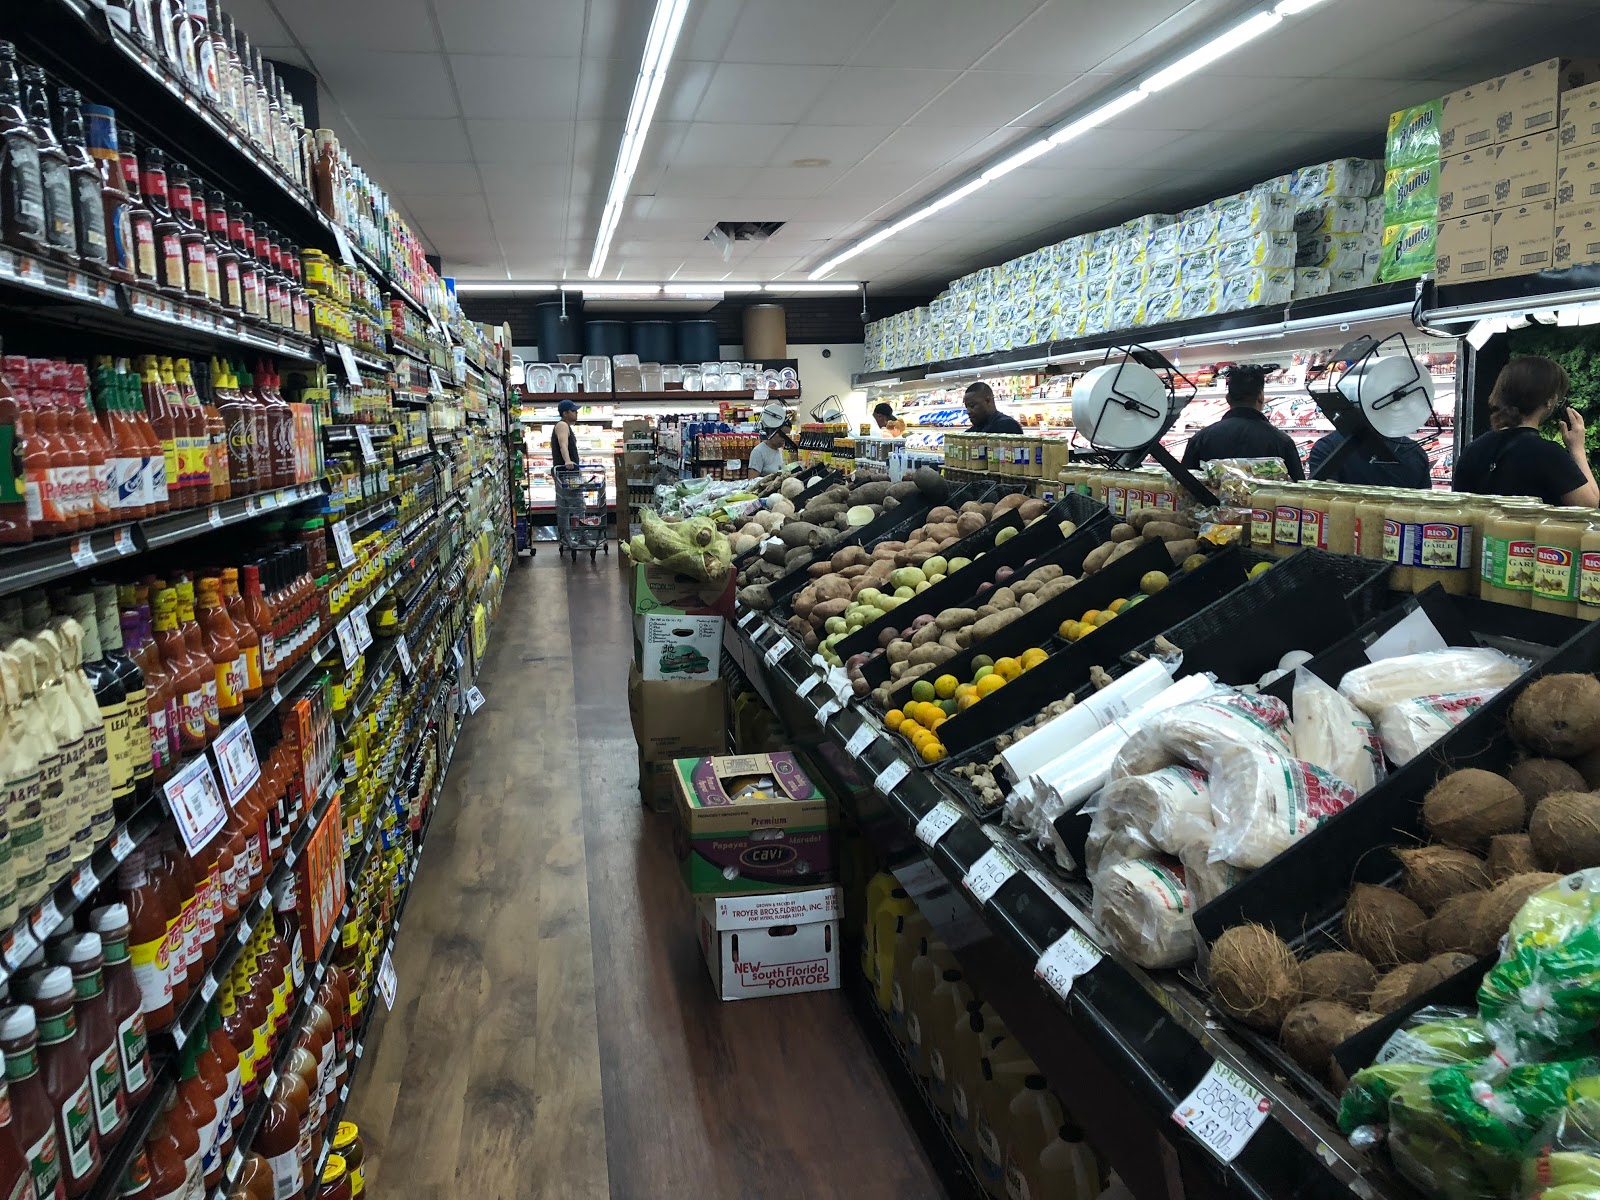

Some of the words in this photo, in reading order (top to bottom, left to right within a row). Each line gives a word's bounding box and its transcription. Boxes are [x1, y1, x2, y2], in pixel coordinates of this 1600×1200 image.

[1399, 110, 1433, 150] Bounty
[1397, 168, 1431, 204] Bounty
[1395, 226, 1430, 262] Bounty
[1427, 529, 1448, 537] RICO
[1423, 540, 1457, 549] GARLIC
[1538, 551, 1559, 560] RICO
[1536, 564, 1569, 576] GARLIC
[751, 816, 787, 826] Premium
[712, 841, 748, 851] Papayas
[982, 859, 1005, 884] HILO
[732, 909, 758, 918] TROYER
[809, 902, 823, 912] INC.
[1070, 930, 1100, 960] SPECIAL
[734, 961, 761, 975] NEW
[786, 962, 825, 977] Florida
[1043, 964, 1067, 991] $5.99
[768, 973, 830, 989] POTATOES
[1214, 1061, 1261, 1105] SPECIAL
[1207, 1077, 1255, 1122] TROPICAL
[1196, 1087, 1254, 1136] COCONUT
[1188, 1110, 1233, 1150] 2/$3.00
